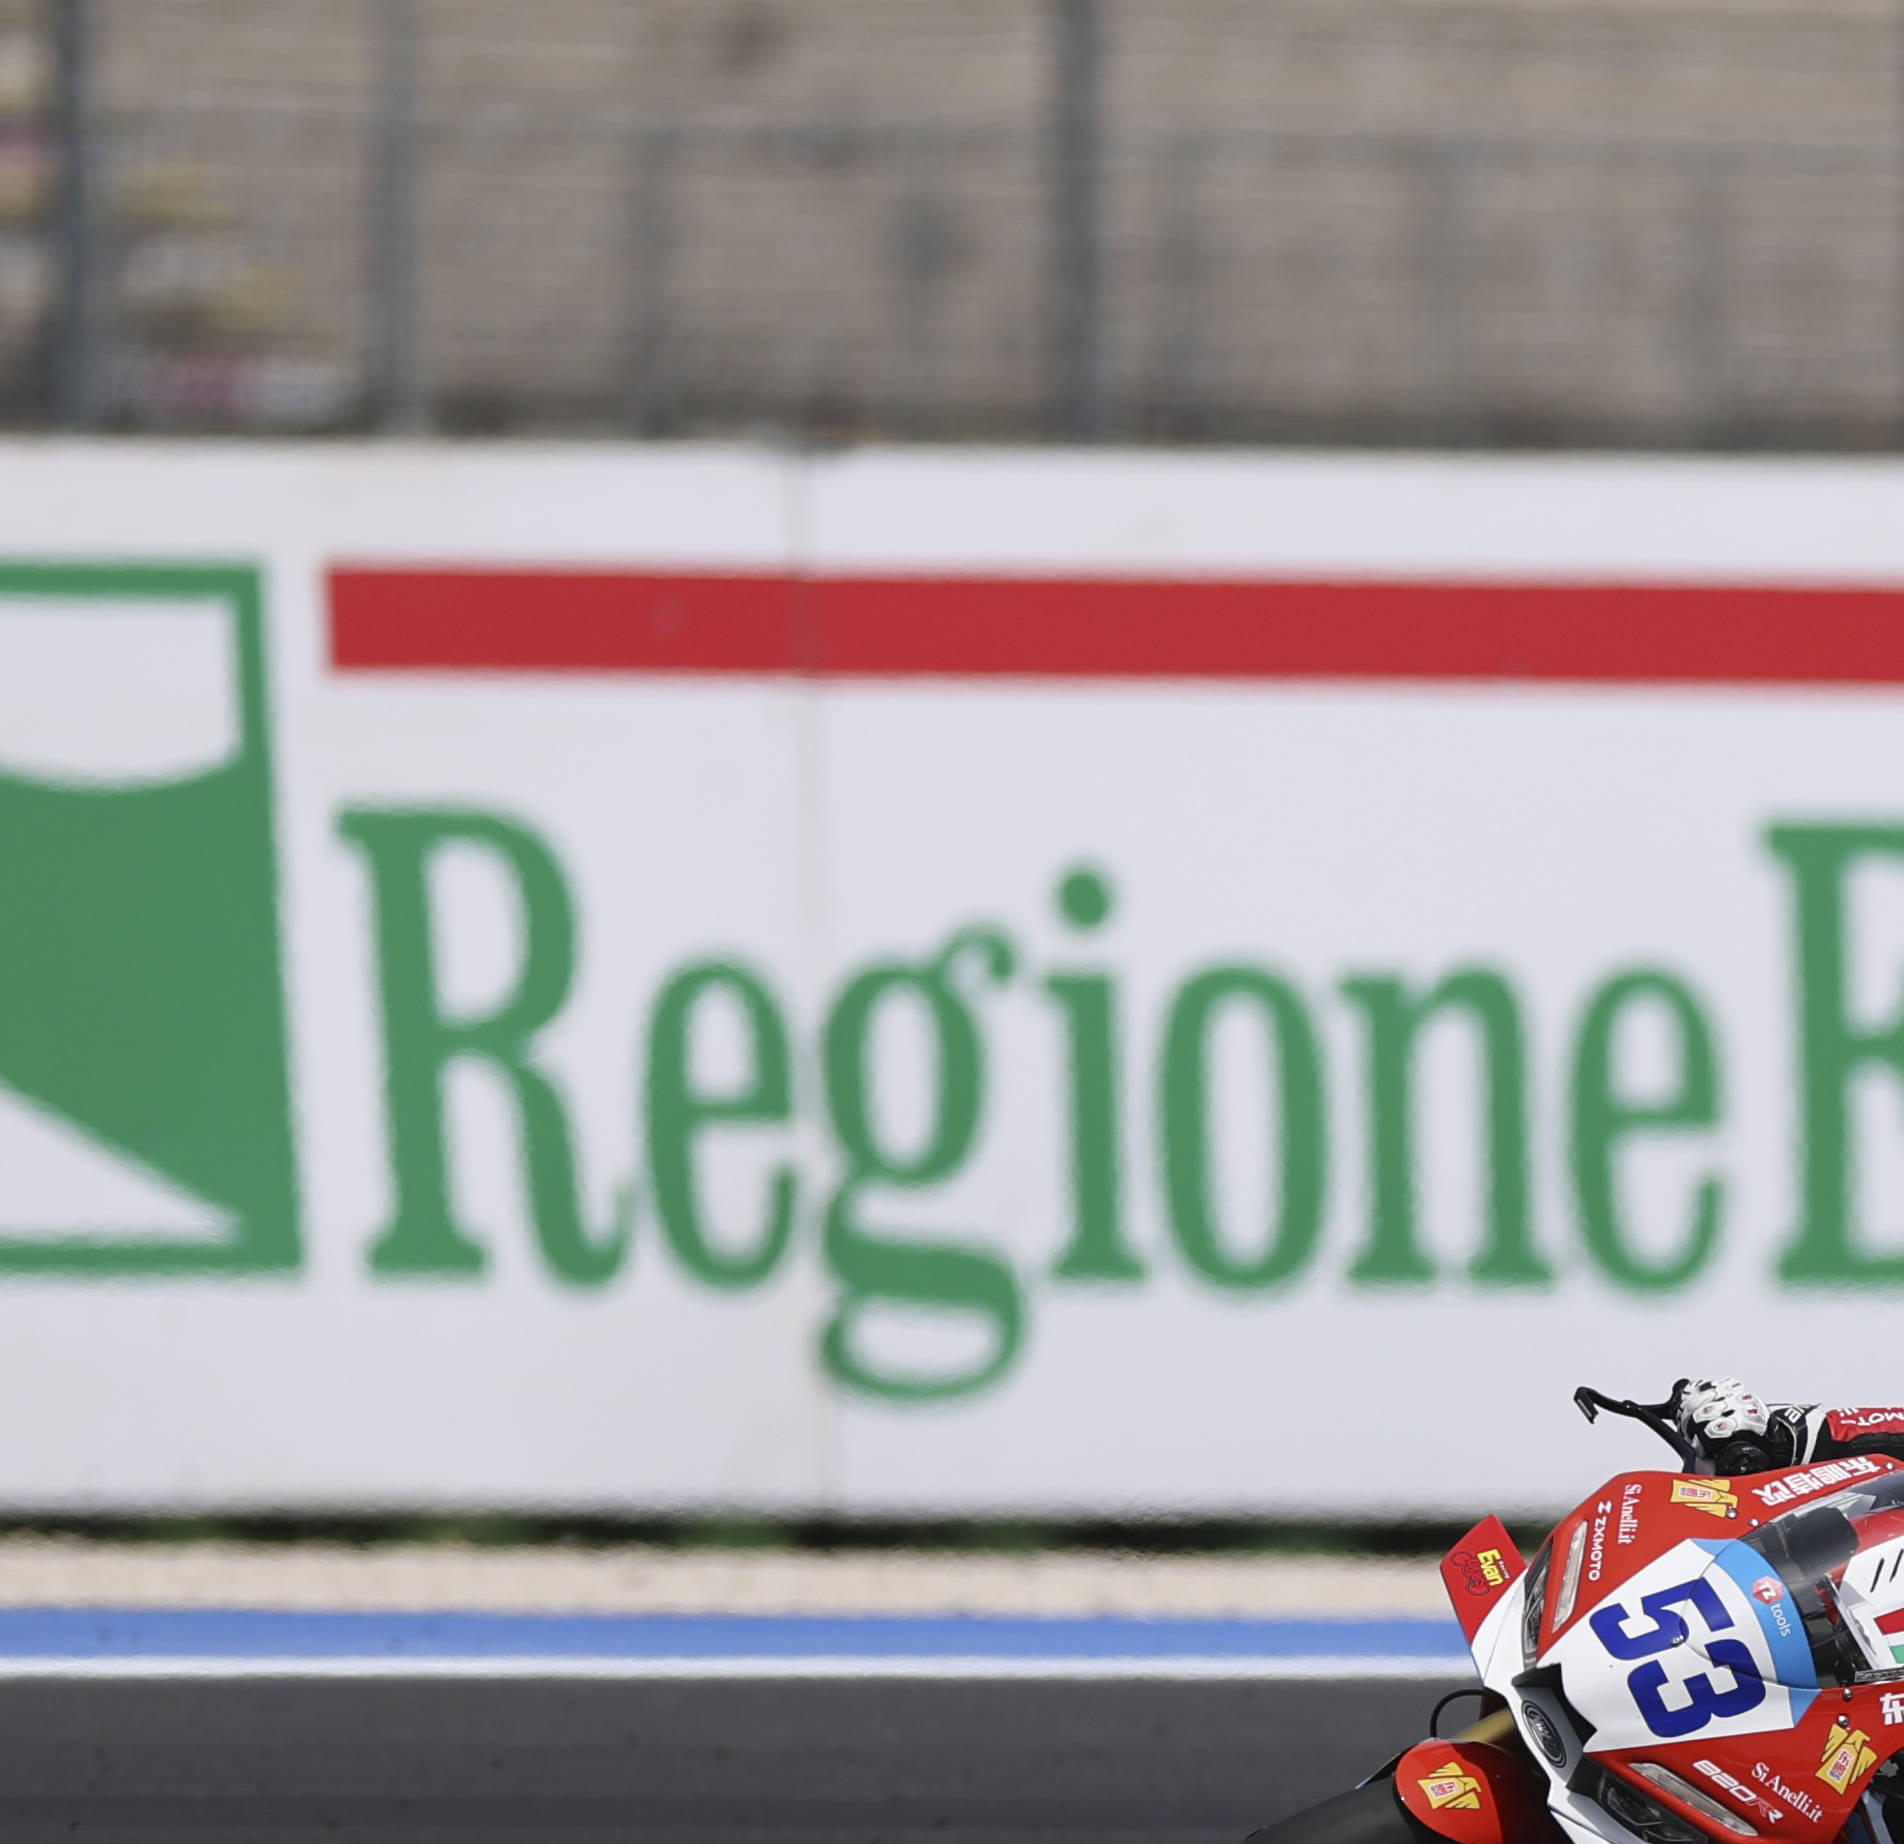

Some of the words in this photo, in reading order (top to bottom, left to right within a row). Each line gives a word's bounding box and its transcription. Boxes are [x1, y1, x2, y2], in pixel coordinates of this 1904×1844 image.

[1476, 1548, 1504, 1586] Evan
[1588, 1517, 1606, 1582] ZXMOTO
[1771, 1603, 1792, 1637] tools
[1589, 1576, 1766, 1737] 53
